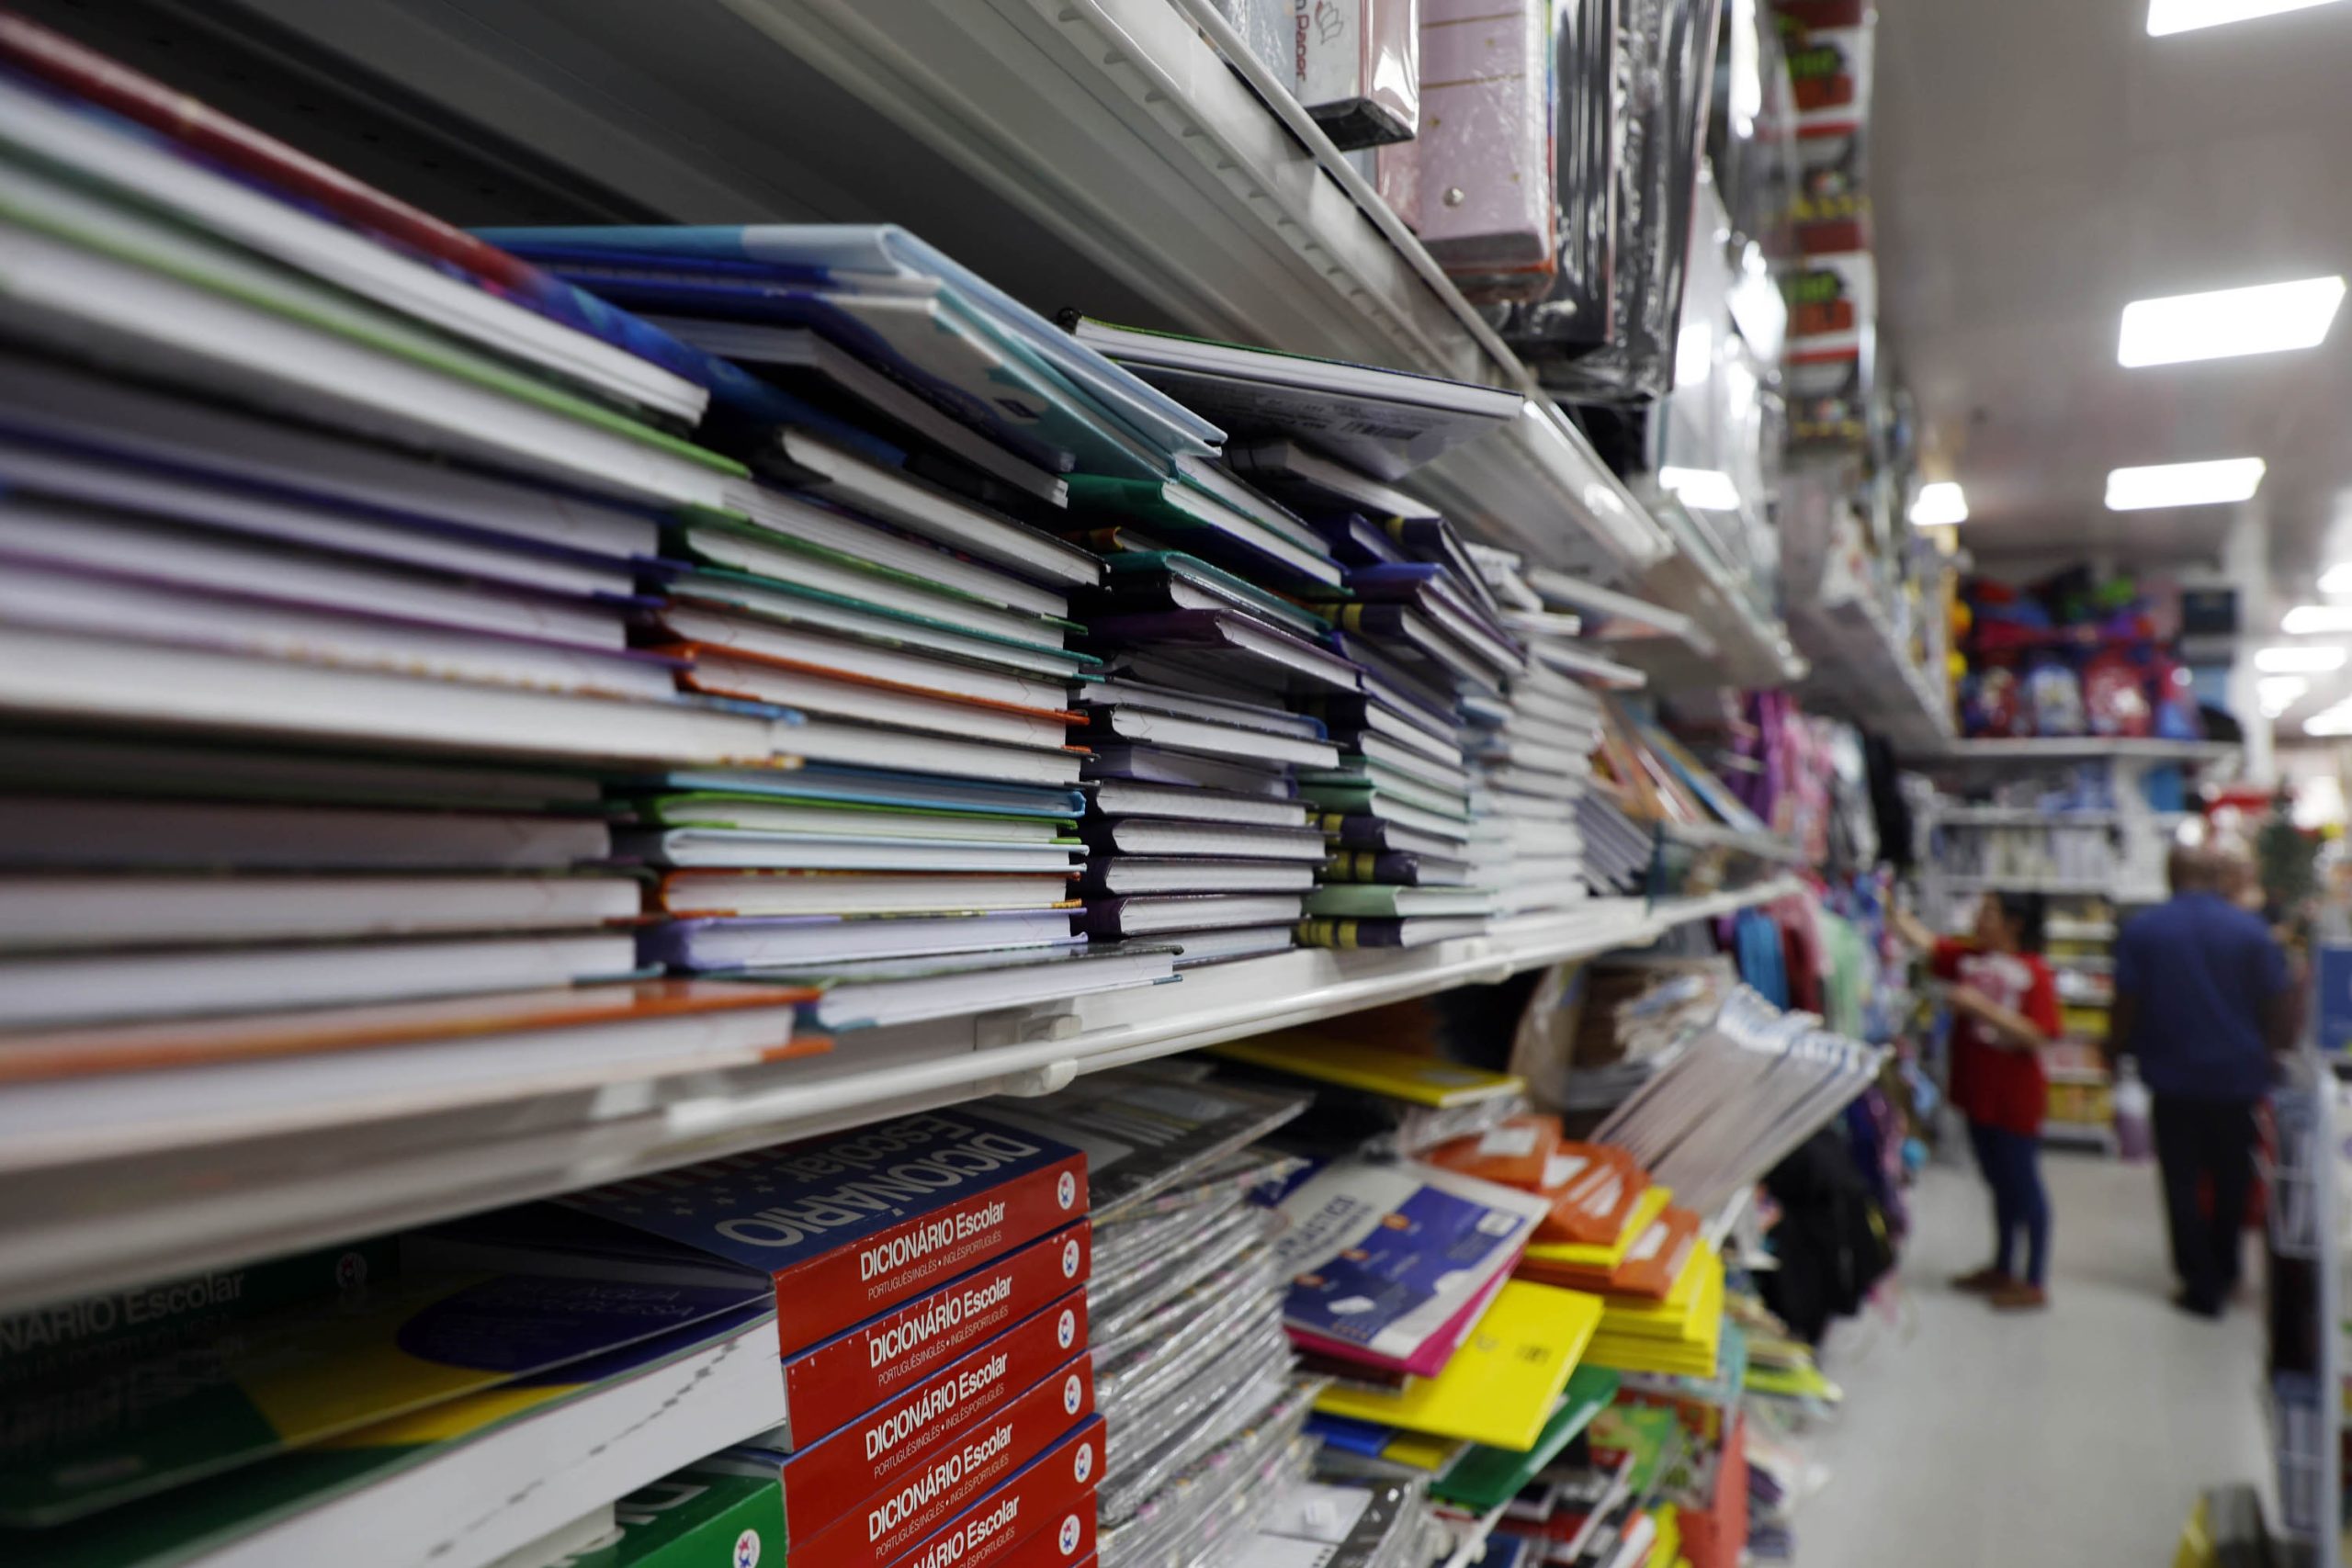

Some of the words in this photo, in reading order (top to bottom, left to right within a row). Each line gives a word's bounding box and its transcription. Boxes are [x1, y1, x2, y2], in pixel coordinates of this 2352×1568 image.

[714, 1132, 1042, 1247] DICIONÁRIO
[860, 1218, 954, 1281] DICIONÁRIO
[956, 1201, 1005, 1240] Escolar
[123, 1270, 245, 1325] Escolar
[870, 1296, 961, 1368] DICIONÁRIO
[964, 1275, 1012, 1318] Escolar
[865, 1380, 956, 1461] DICIONÁRIO
[959, 1353, 1008, 1401] Escolar
[868, 1454, 961, 1543] DICIONÁRIO
[964, 1423, 1012, 1474] Escolar
[967, 1495, 1020, 1550] Escolar
